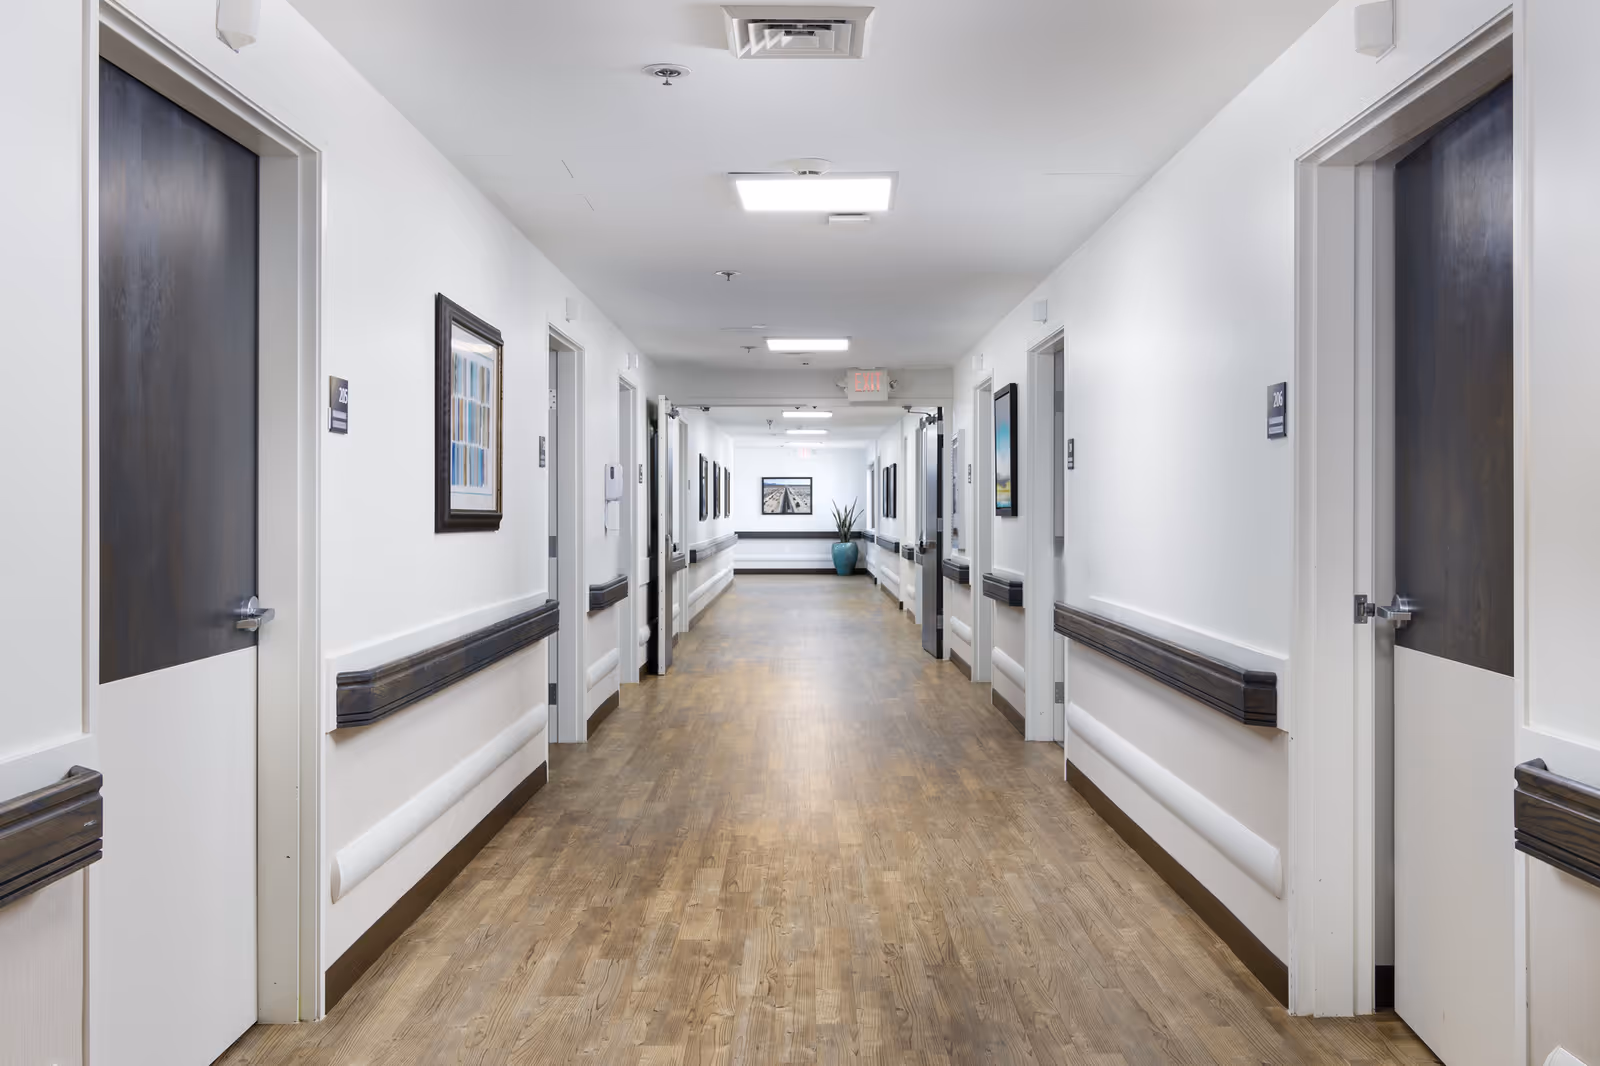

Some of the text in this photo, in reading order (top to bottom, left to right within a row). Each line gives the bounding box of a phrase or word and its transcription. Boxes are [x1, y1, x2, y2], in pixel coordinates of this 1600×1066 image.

[854, 371, 882, 393] EXIT
[338, 387, 348, 405] 205
[1273, 390, 1283, 408] 206
